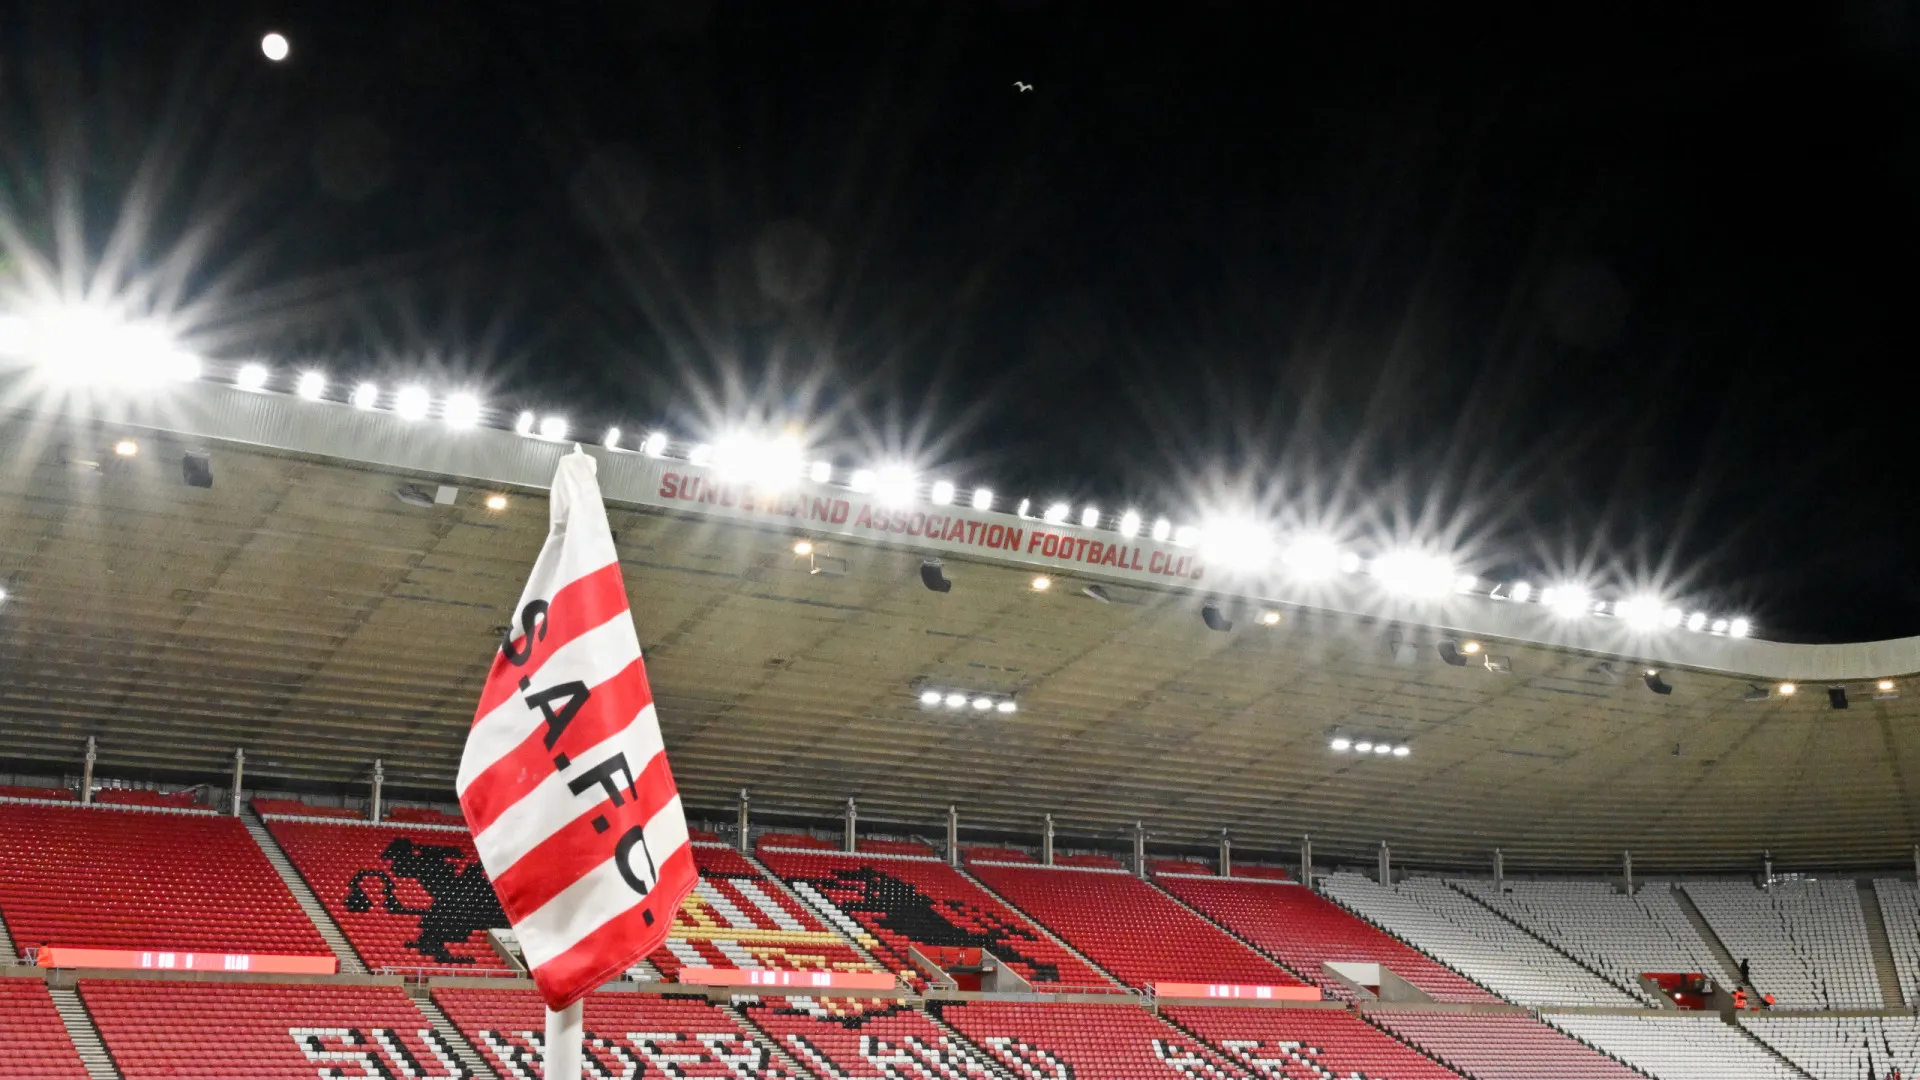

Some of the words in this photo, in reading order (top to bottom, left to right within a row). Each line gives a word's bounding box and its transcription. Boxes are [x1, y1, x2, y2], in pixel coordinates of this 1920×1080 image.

[659, 472, 850, 525] SUNDLAND
[854, 504, 1024, 552] ASSOCIATION
[1026, 531, 1144, 571] FOOTBALL
